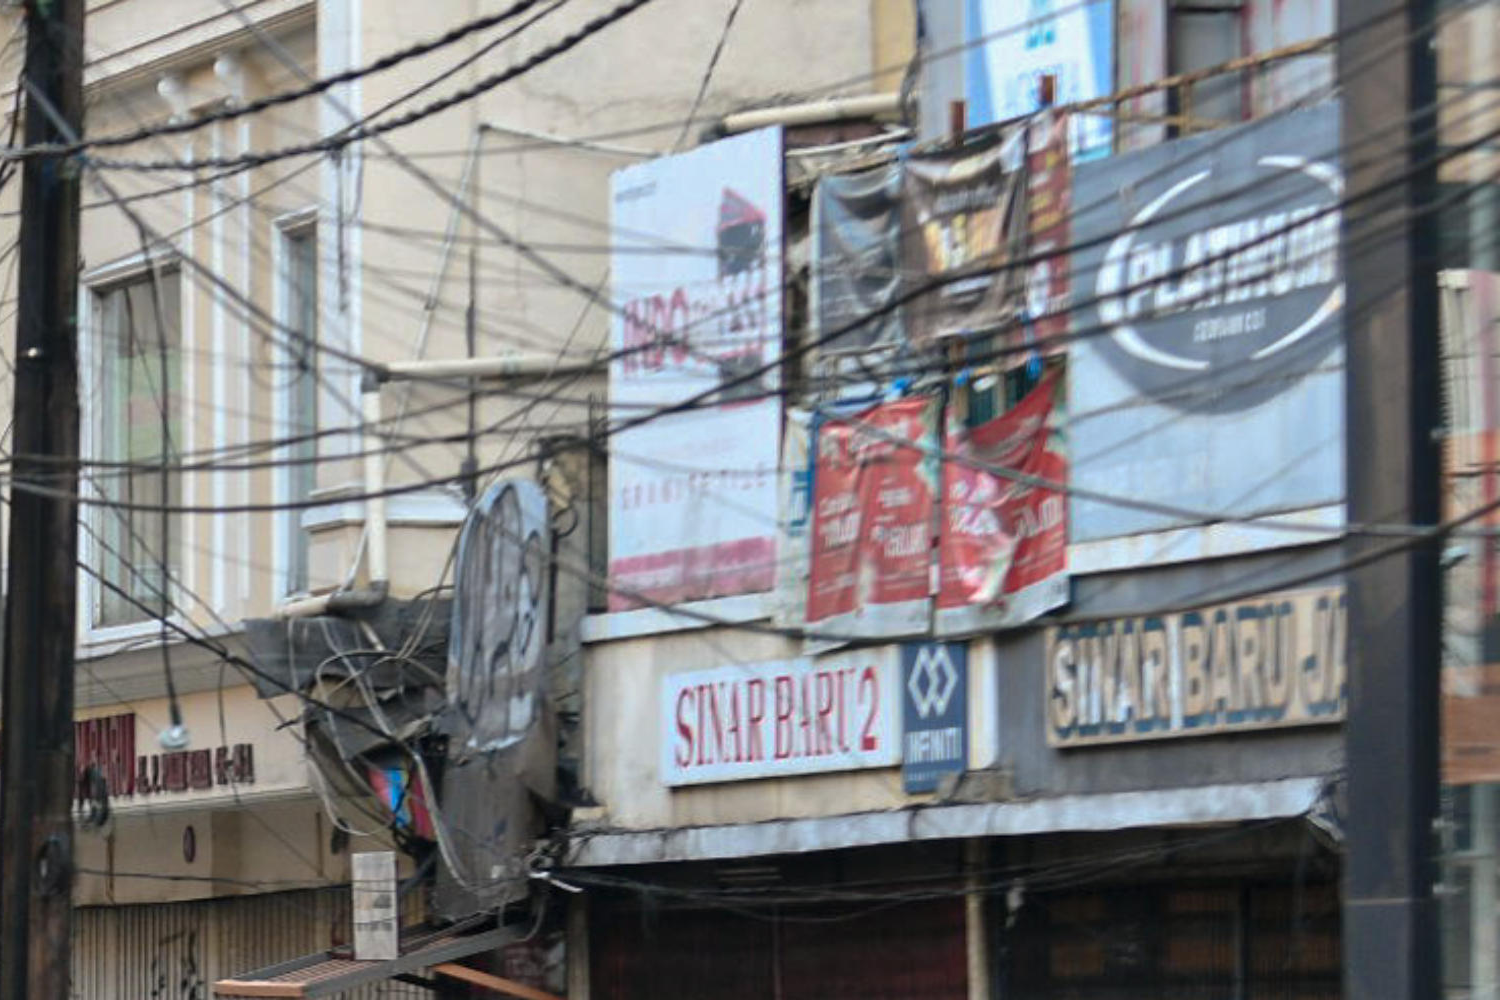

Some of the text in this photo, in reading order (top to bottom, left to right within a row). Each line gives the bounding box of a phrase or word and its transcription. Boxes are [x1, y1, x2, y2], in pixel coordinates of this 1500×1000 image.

[674, 665, 881, 769] SINAR BARU 2
[1052, 616, 1171, 739] SINAR
[1180, 599, 1296, 729] BARU
